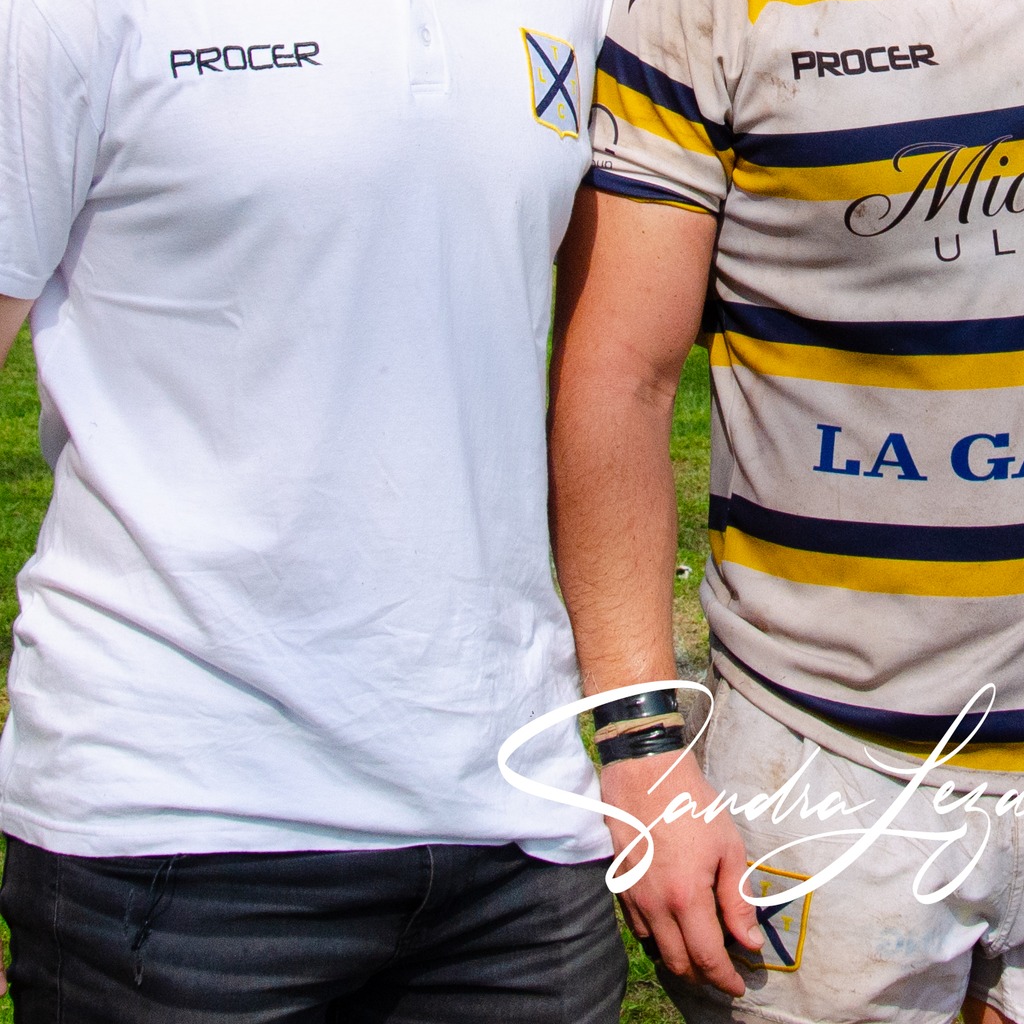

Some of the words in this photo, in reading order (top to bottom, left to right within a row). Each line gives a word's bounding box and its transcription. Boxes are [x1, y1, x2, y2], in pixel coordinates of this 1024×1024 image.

[170, 41, 321, 79] PROCER
[790, 44, 939, 80] PROCER
[813, 424, 927, 480] LA
